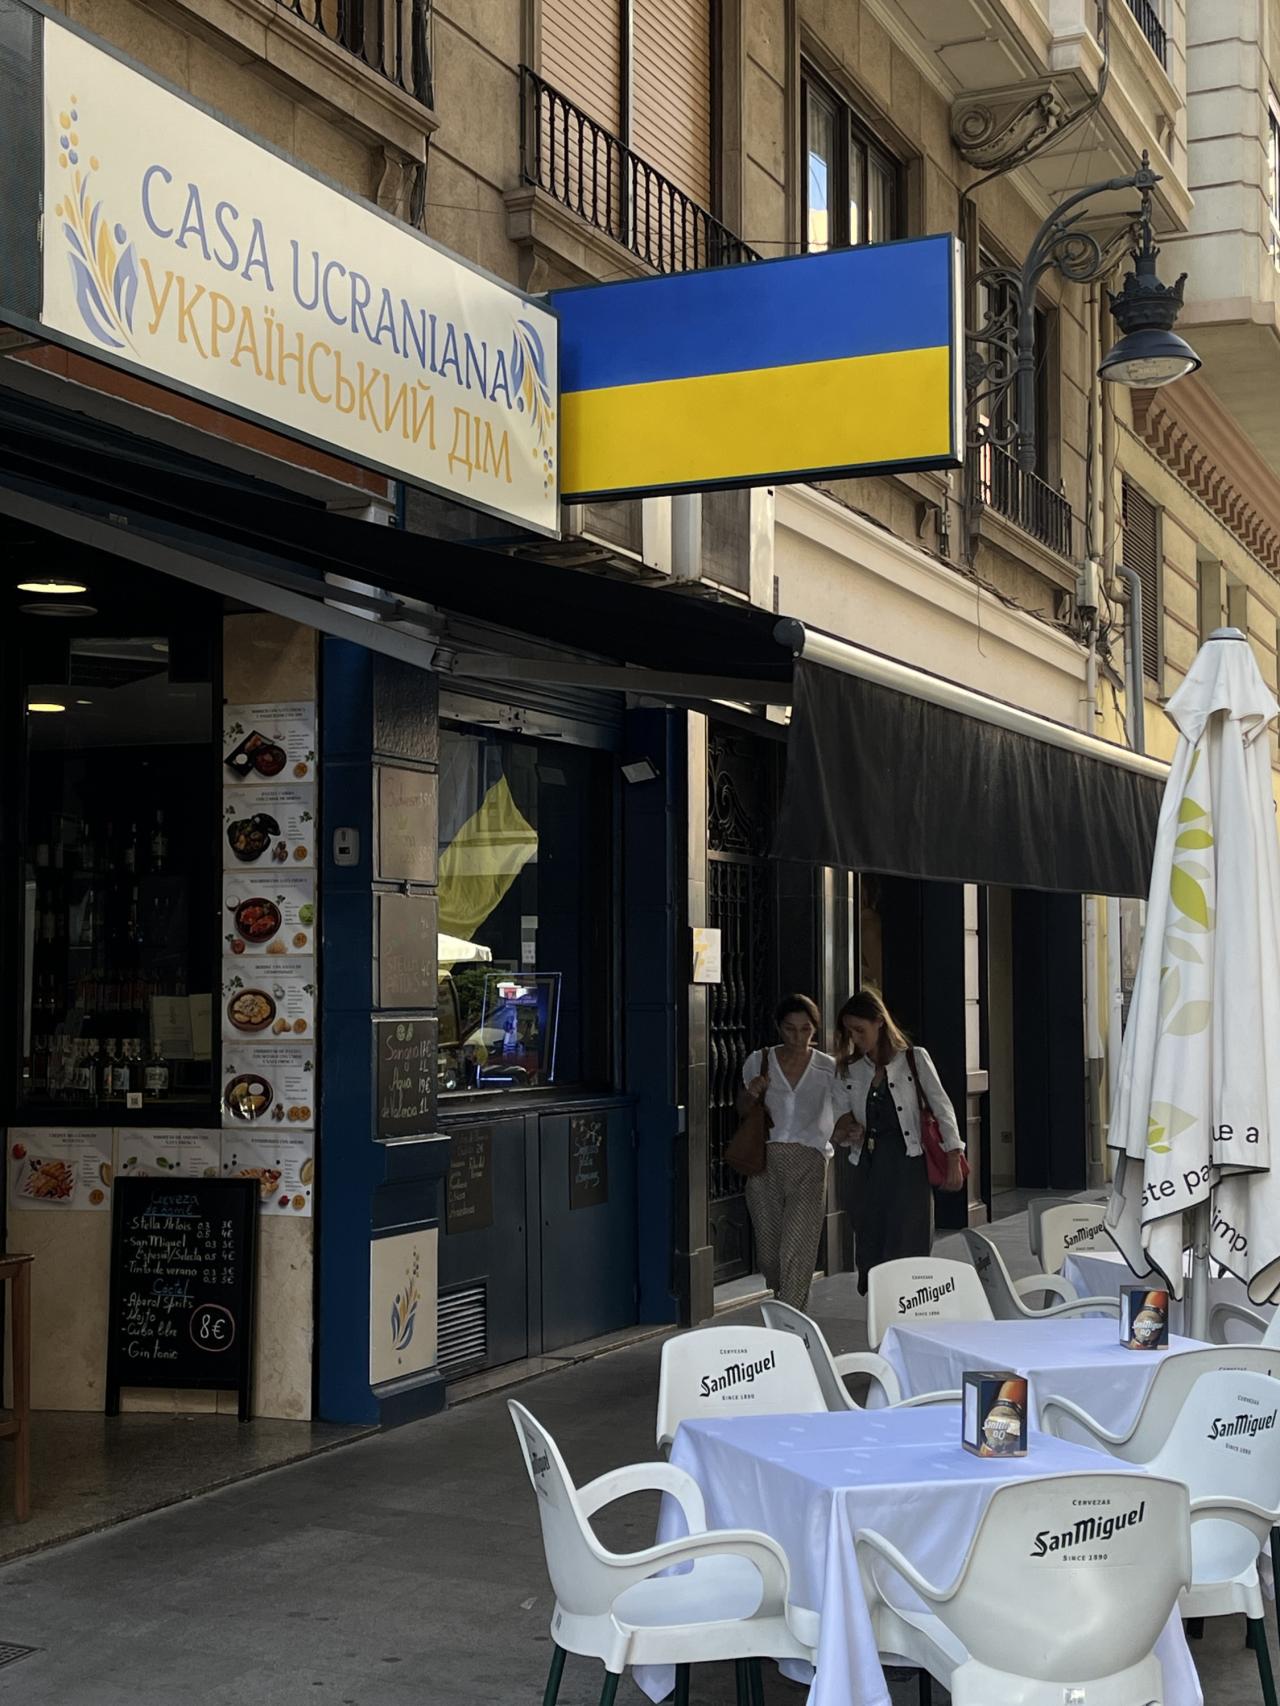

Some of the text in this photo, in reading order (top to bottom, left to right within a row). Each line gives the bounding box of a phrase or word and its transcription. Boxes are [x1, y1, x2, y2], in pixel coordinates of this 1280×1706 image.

[141, 164, 513, 410] CASA UCRANIANA
[141, 258, 512, 483] УКРАЇНСЬКИЙ ДІМ
[1246, 1126, 1260, 1143] a
[898, 1276, 956, 1314] SanMiguel
[199, 1314, 226, 1340] 8€
[128, 1340, 149, 1359] Gin
[699, 1350, 776, 1397] SanMiguel
[1207, 1408, 1278, 1440] SanMiguel
[1029, 1500, 1145, 1557] SanMiguel
